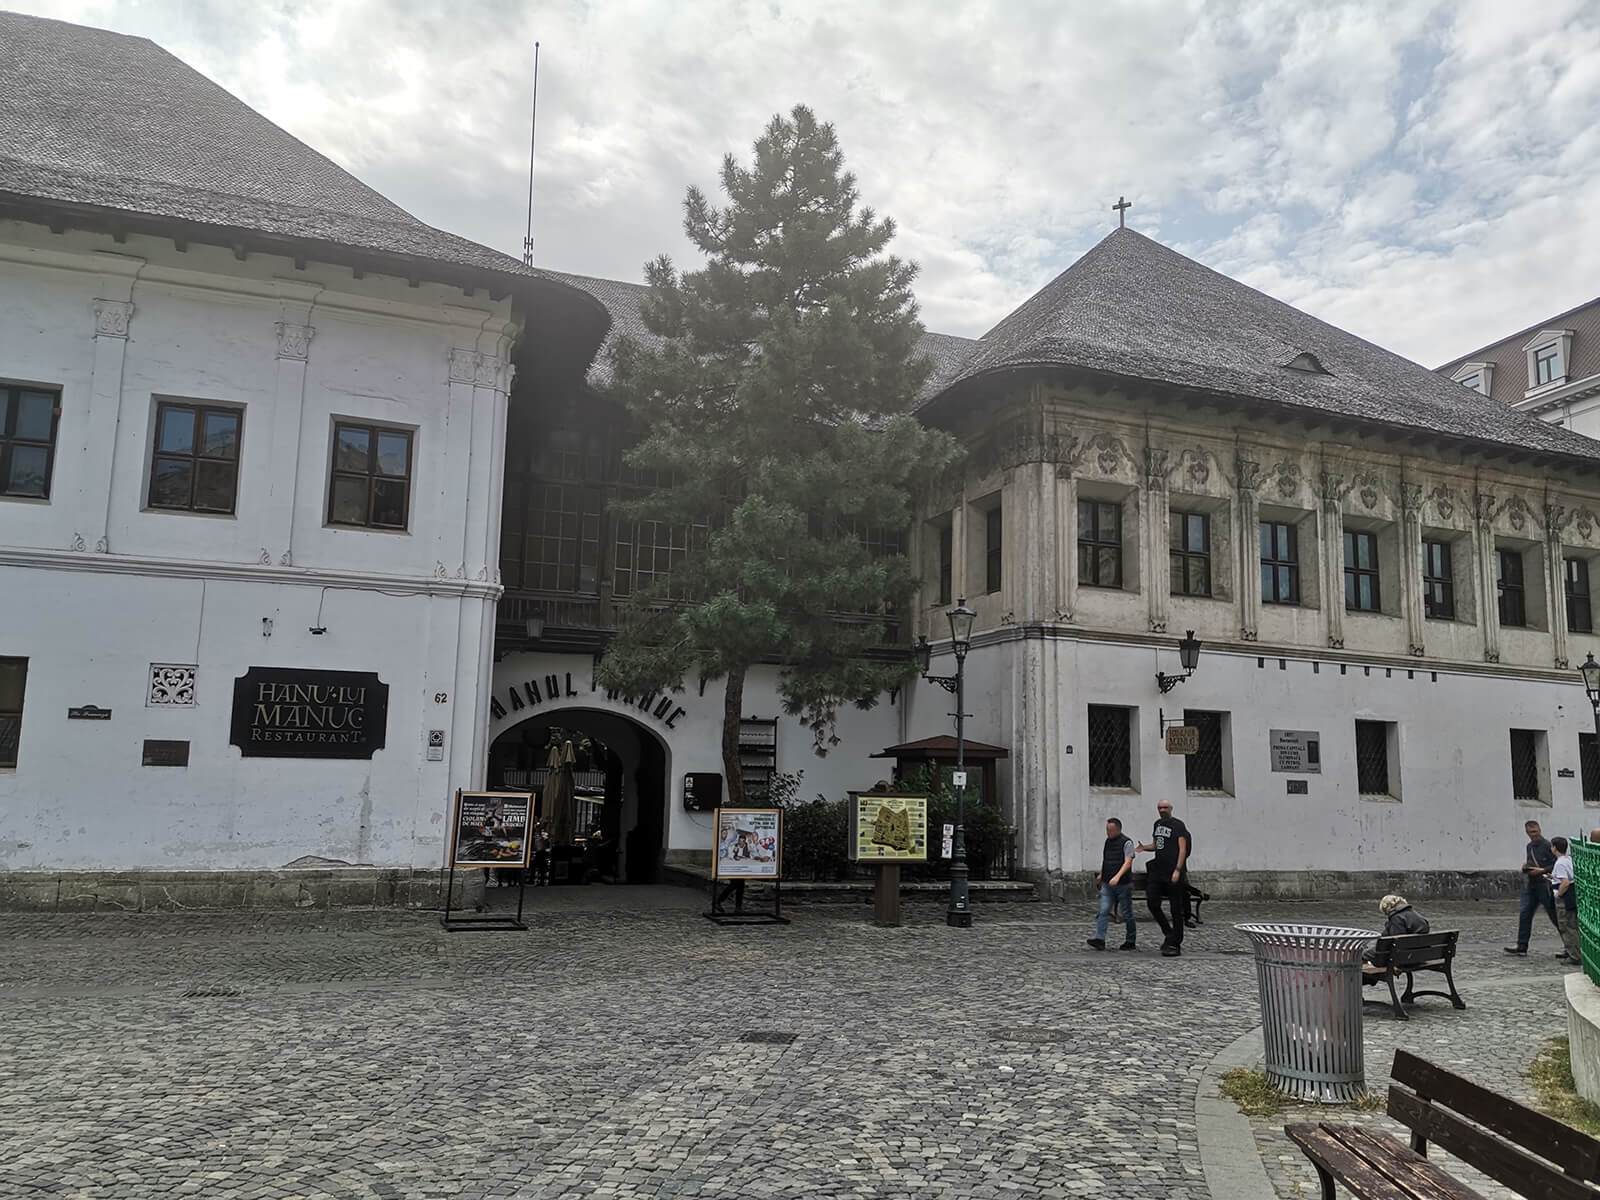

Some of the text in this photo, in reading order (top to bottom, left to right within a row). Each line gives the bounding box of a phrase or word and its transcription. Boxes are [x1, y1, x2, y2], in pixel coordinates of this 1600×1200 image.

[434, 692, 448, 704] 62
[606, 687, 686, 729] NUC
[251, 703, 364, 729] MANUC
[251, 728, 362, 743] RESTAURANT
